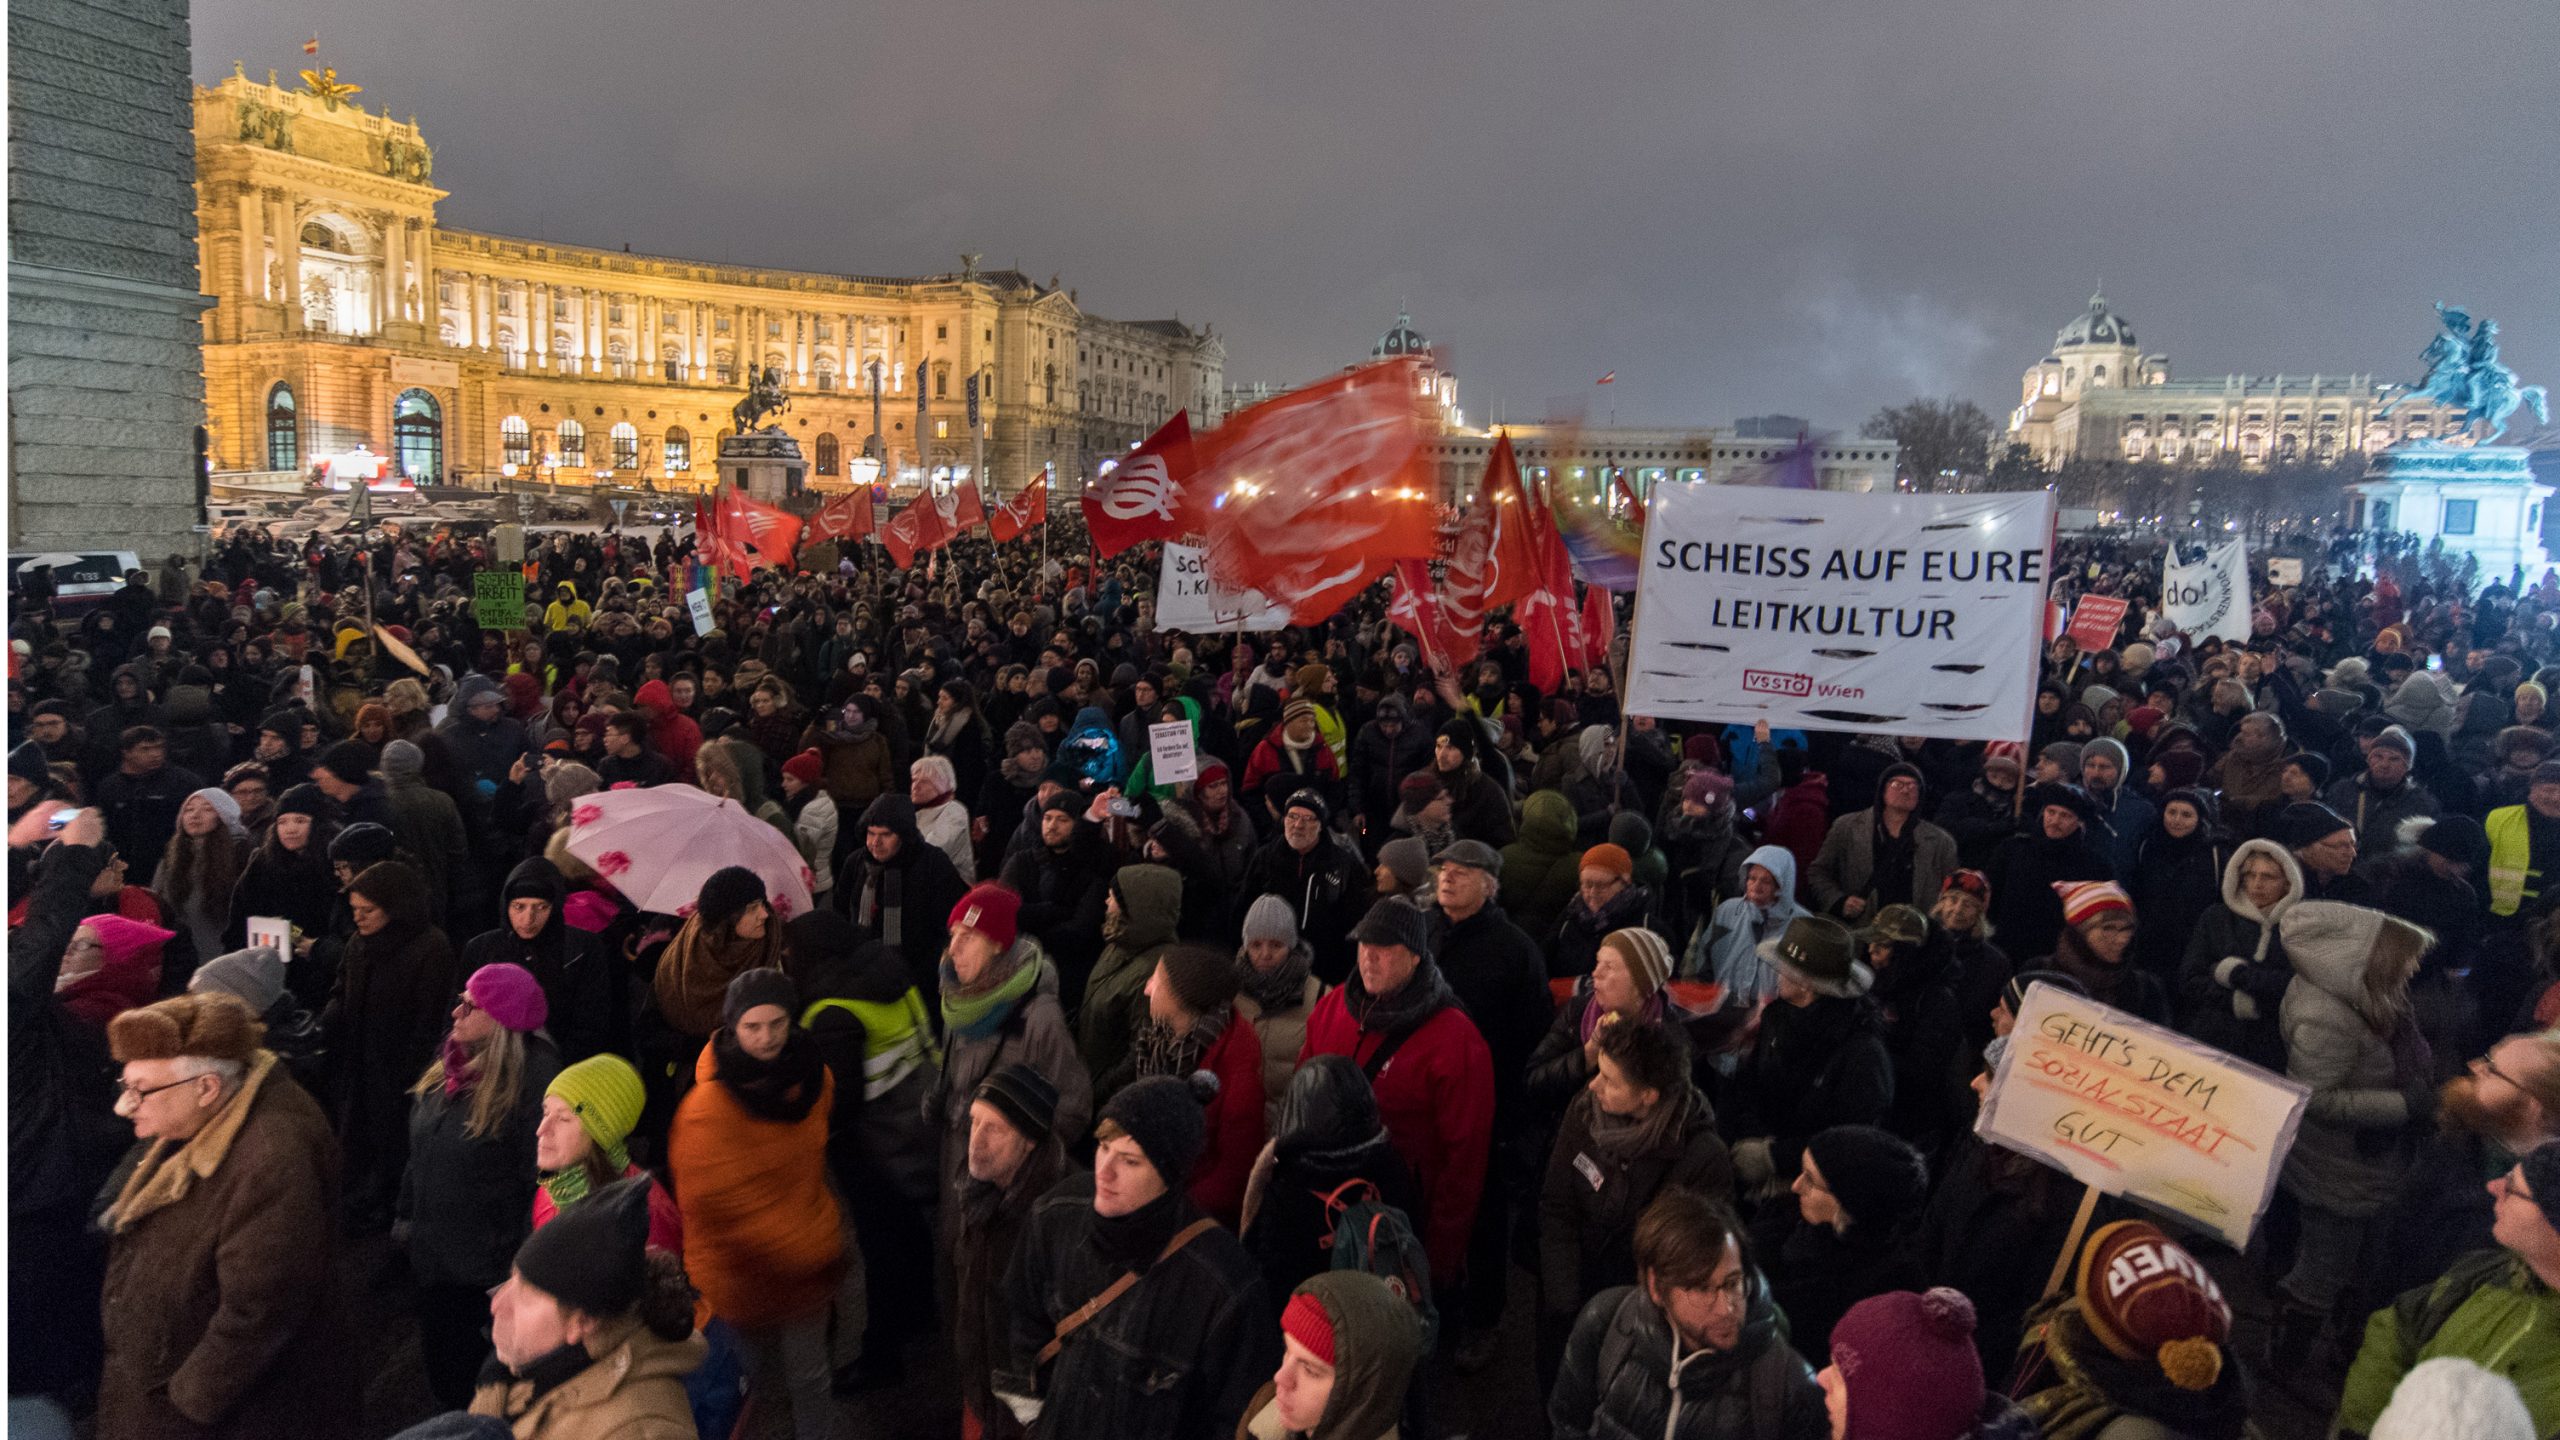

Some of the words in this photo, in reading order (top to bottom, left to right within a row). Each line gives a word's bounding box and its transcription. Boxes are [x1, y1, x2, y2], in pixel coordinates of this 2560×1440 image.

[1656, 539, 1811, 578] SCHEISS
[1821, 549, 1908, 582] AUF
[1921, 550, 2044, 584] EURE
[477, 586, 521, 600] ARBEIT
[2167, 578, 2209, 606] do!
[1712, 597, 1956, 641] LEITKULTUR
[1818, 685, 1865, 699] Wien
[2041, 1012, 2137, 1068] GEHT'S
[2142, 1056, 2219, 1110] DEM
[2025, 1050, 2256, 1157] SOZIALSTAAT
[2054, 1112, 2144, 1153] GUT
